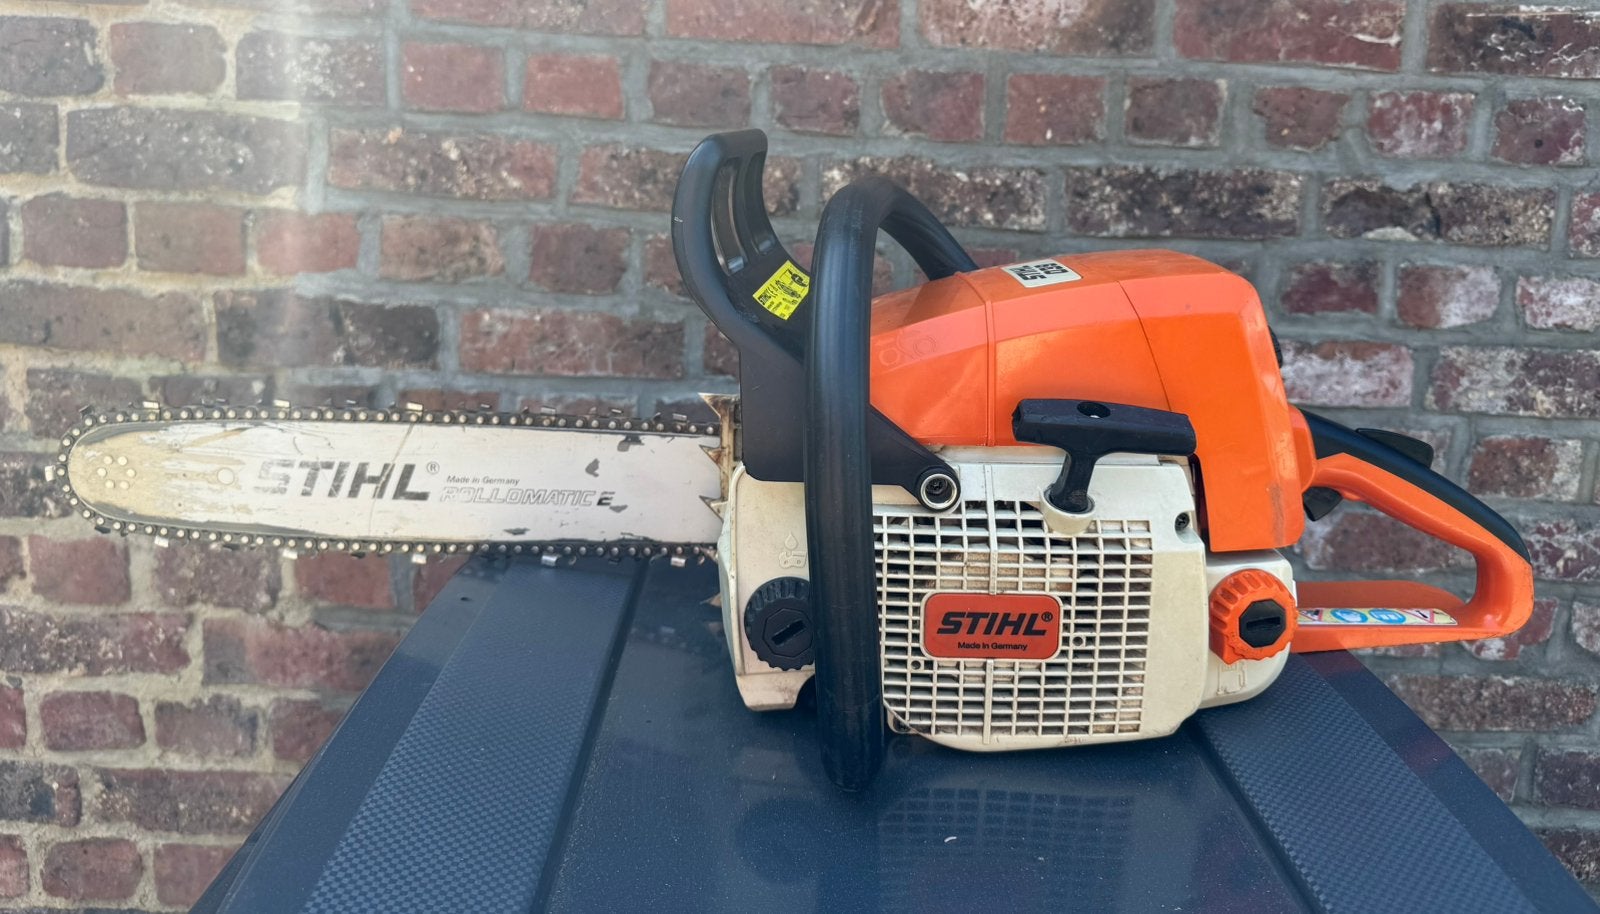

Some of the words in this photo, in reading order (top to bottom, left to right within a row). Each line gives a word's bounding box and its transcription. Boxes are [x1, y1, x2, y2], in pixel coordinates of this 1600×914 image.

[1009, 265, 1047, 280] STIHL
[446, 475, 470, 484] Made
[471, 475, 480, 484] in
[482, 476, 520, 486] Germany
[439, 486, 597, 507] ROLLOMATIC
[596, 490, 615, 507] E
[957, 641, 981, 650] Made
[991, 642, 1028, 652] Germany
